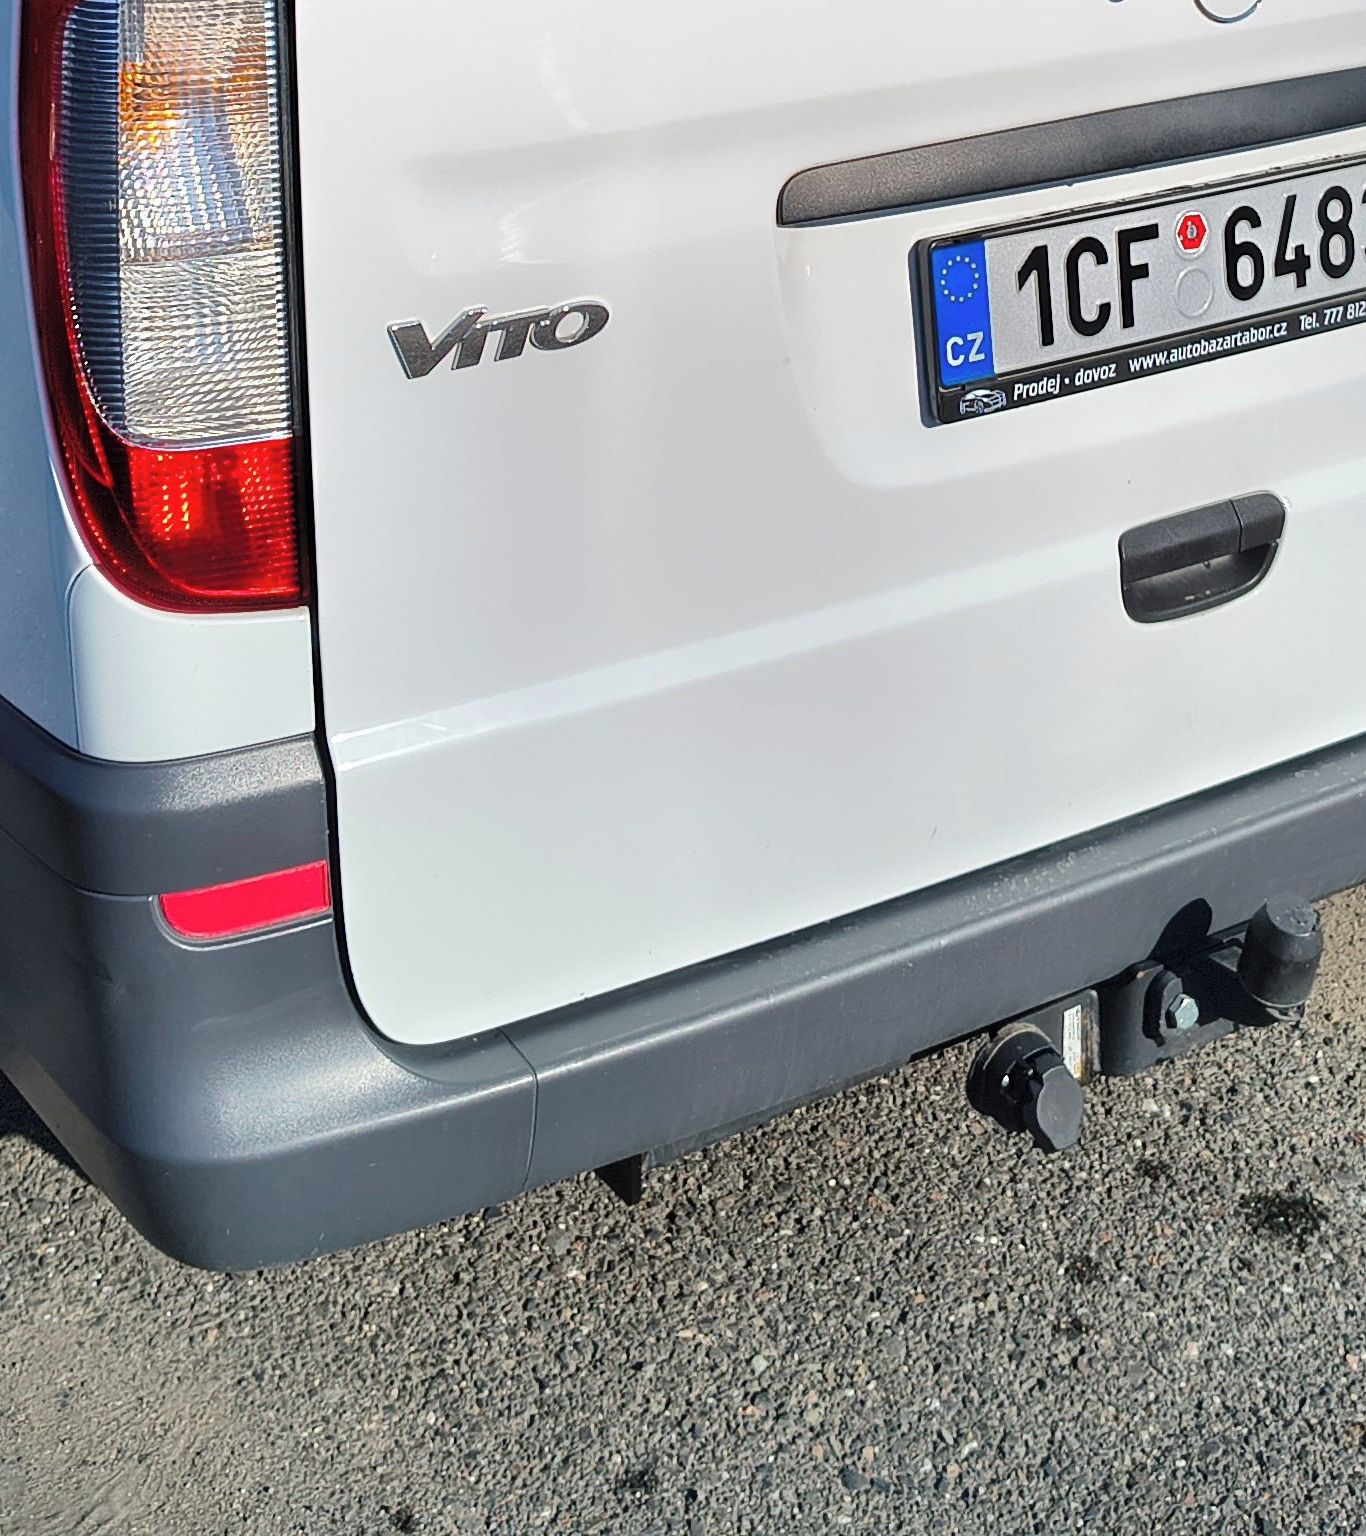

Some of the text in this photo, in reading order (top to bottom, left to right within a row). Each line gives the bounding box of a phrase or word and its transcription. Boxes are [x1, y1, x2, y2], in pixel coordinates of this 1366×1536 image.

[1017, 223, 1160, 347] 1CF
[946, 331, 985, 367] CZ
[1013, 376, 1061, 401] Prodej
[1074, 363, 1117, 387] dovoz
[1128, 320, 1289, 373] www.autobazartabor.cz
[1299, 313, 1320, 332] Tel.
[1323, 306, 1344, 326] 777
[1347, 301, 1366, 320] 812
